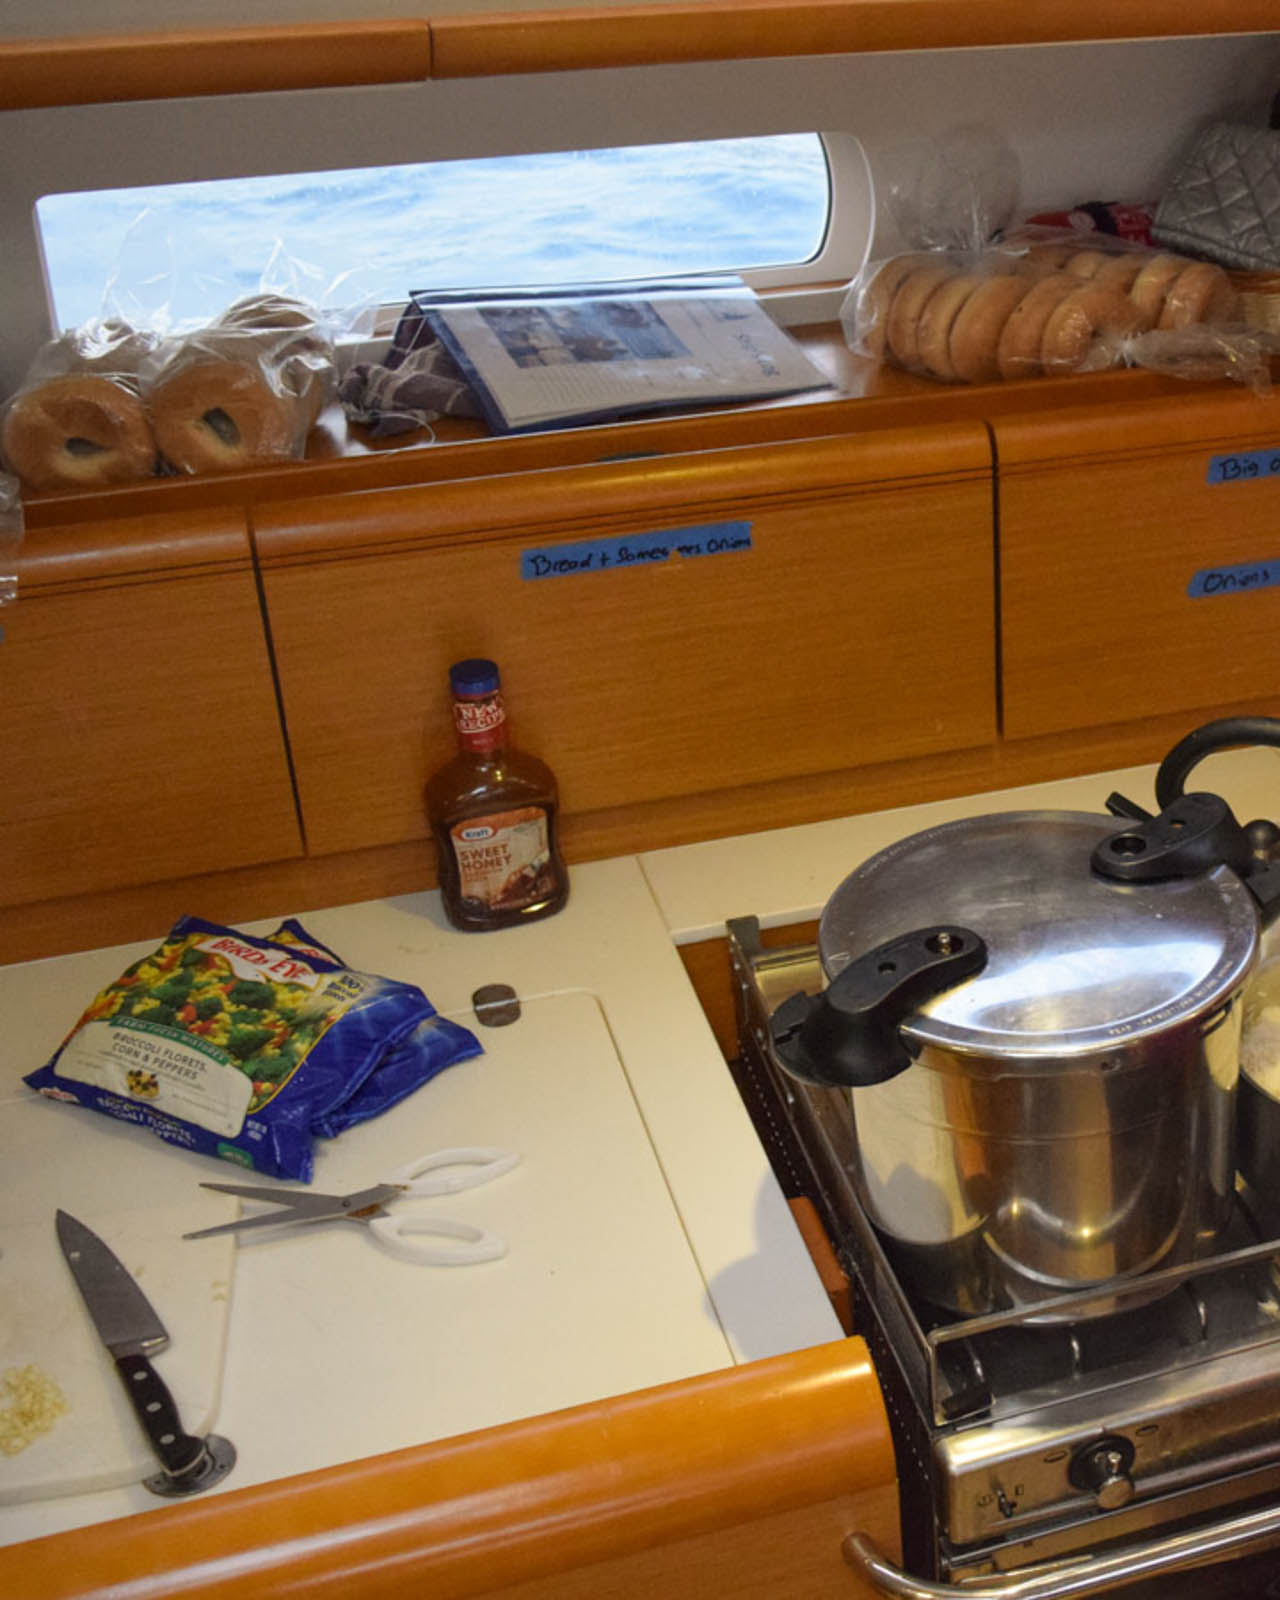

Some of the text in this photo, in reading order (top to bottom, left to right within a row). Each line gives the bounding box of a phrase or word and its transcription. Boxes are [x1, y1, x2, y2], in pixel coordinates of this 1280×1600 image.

[1219, 457, 1258, 481] Big
[529, 553, 593, 577] Bread
[1203, 568, 1270, 593] Onions
[464, 828, 489, 839] Kraft
[460, 843, 509, 862] SWEET
[461, 853, 512, 871] HONEY
[113, 1031, 161, 1054] BROCCOLI
[112, 1042, 199, 1081] CORN & PEPPERS
